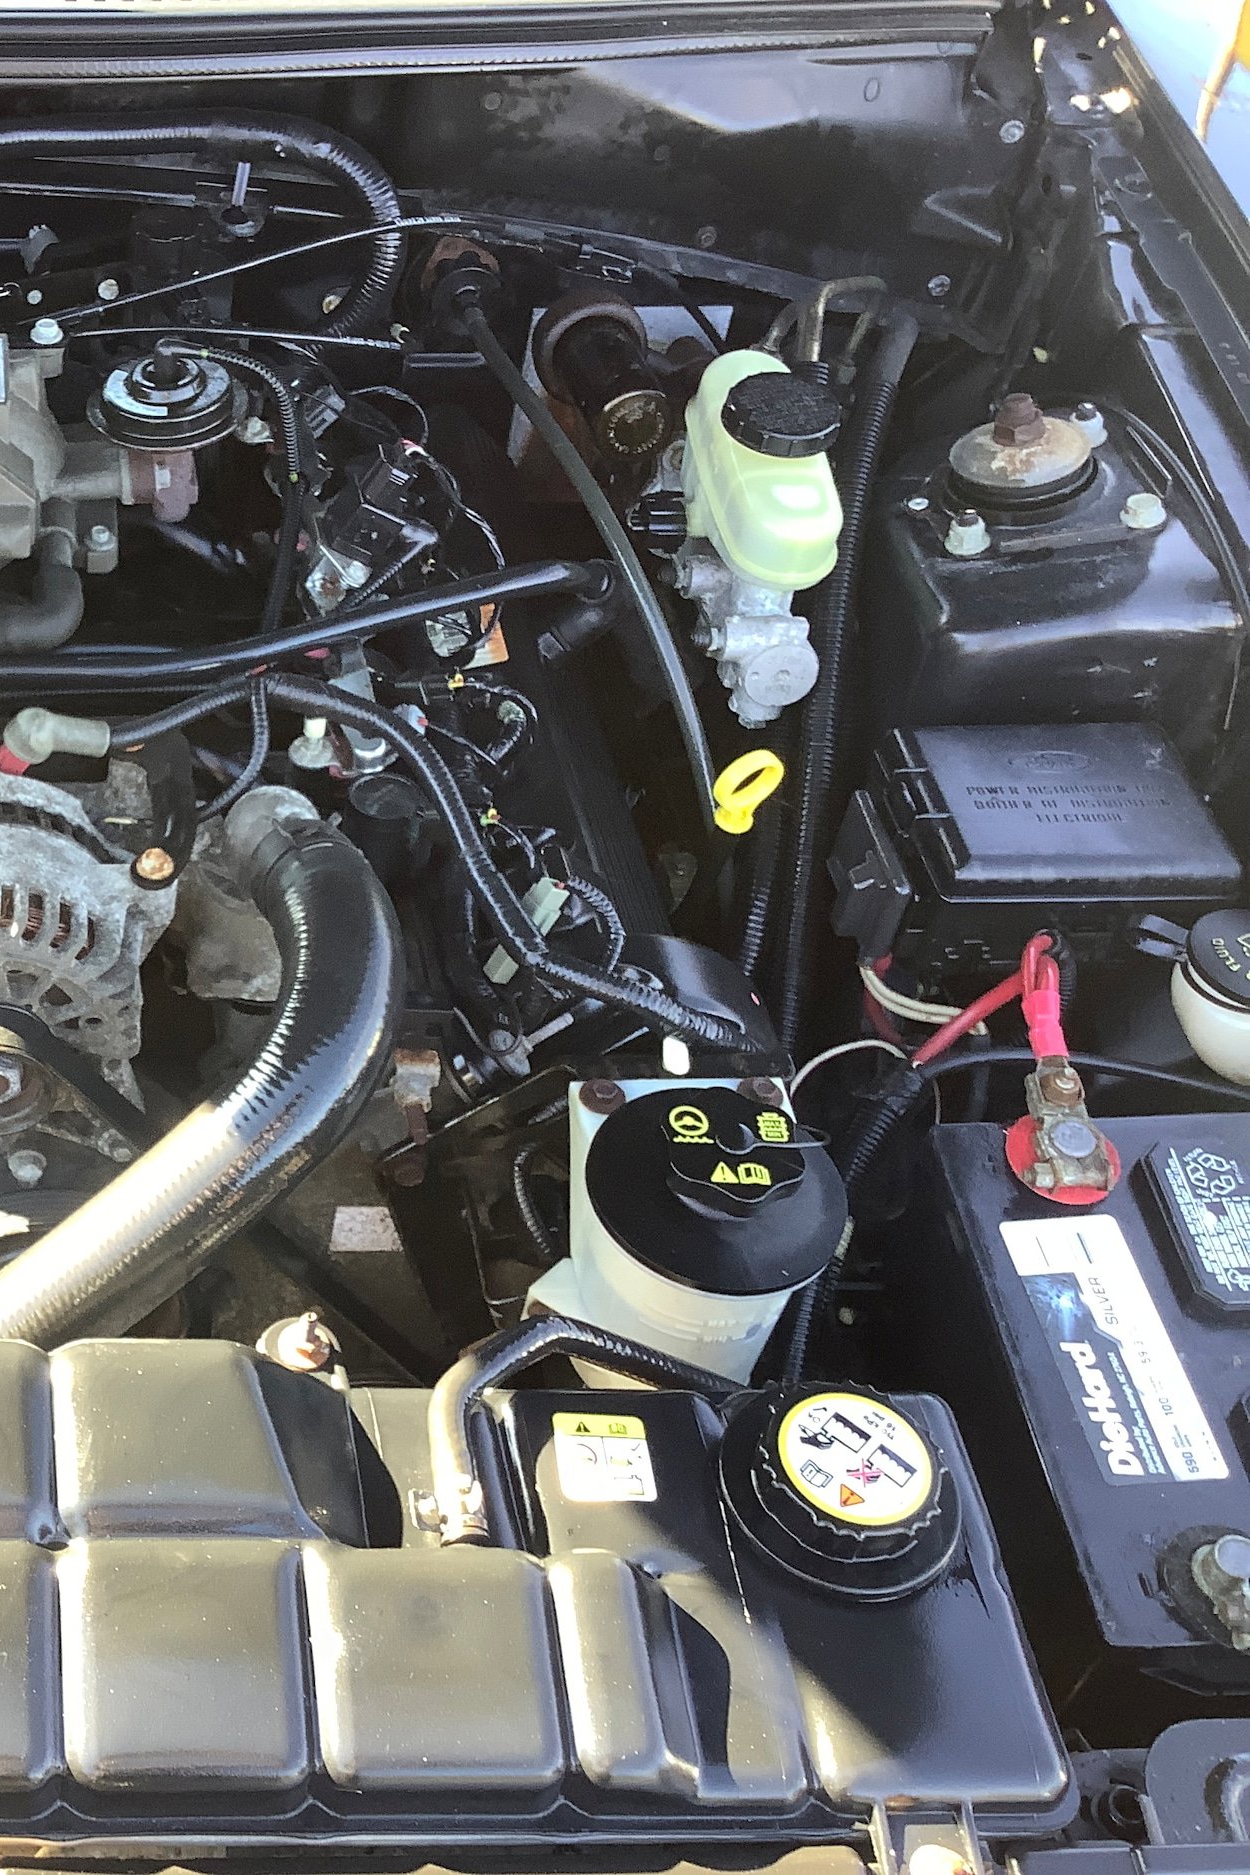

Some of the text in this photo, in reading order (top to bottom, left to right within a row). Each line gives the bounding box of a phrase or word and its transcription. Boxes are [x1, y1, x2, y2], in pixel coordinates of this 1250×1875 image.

[1212, 937, 1241, 972] FLUID
[1088, 1276, 1119, 1325] SILVER
[1059, 1341, 1145, 1476] DieHard
[1182, 1451, 1200, 1474] 590
